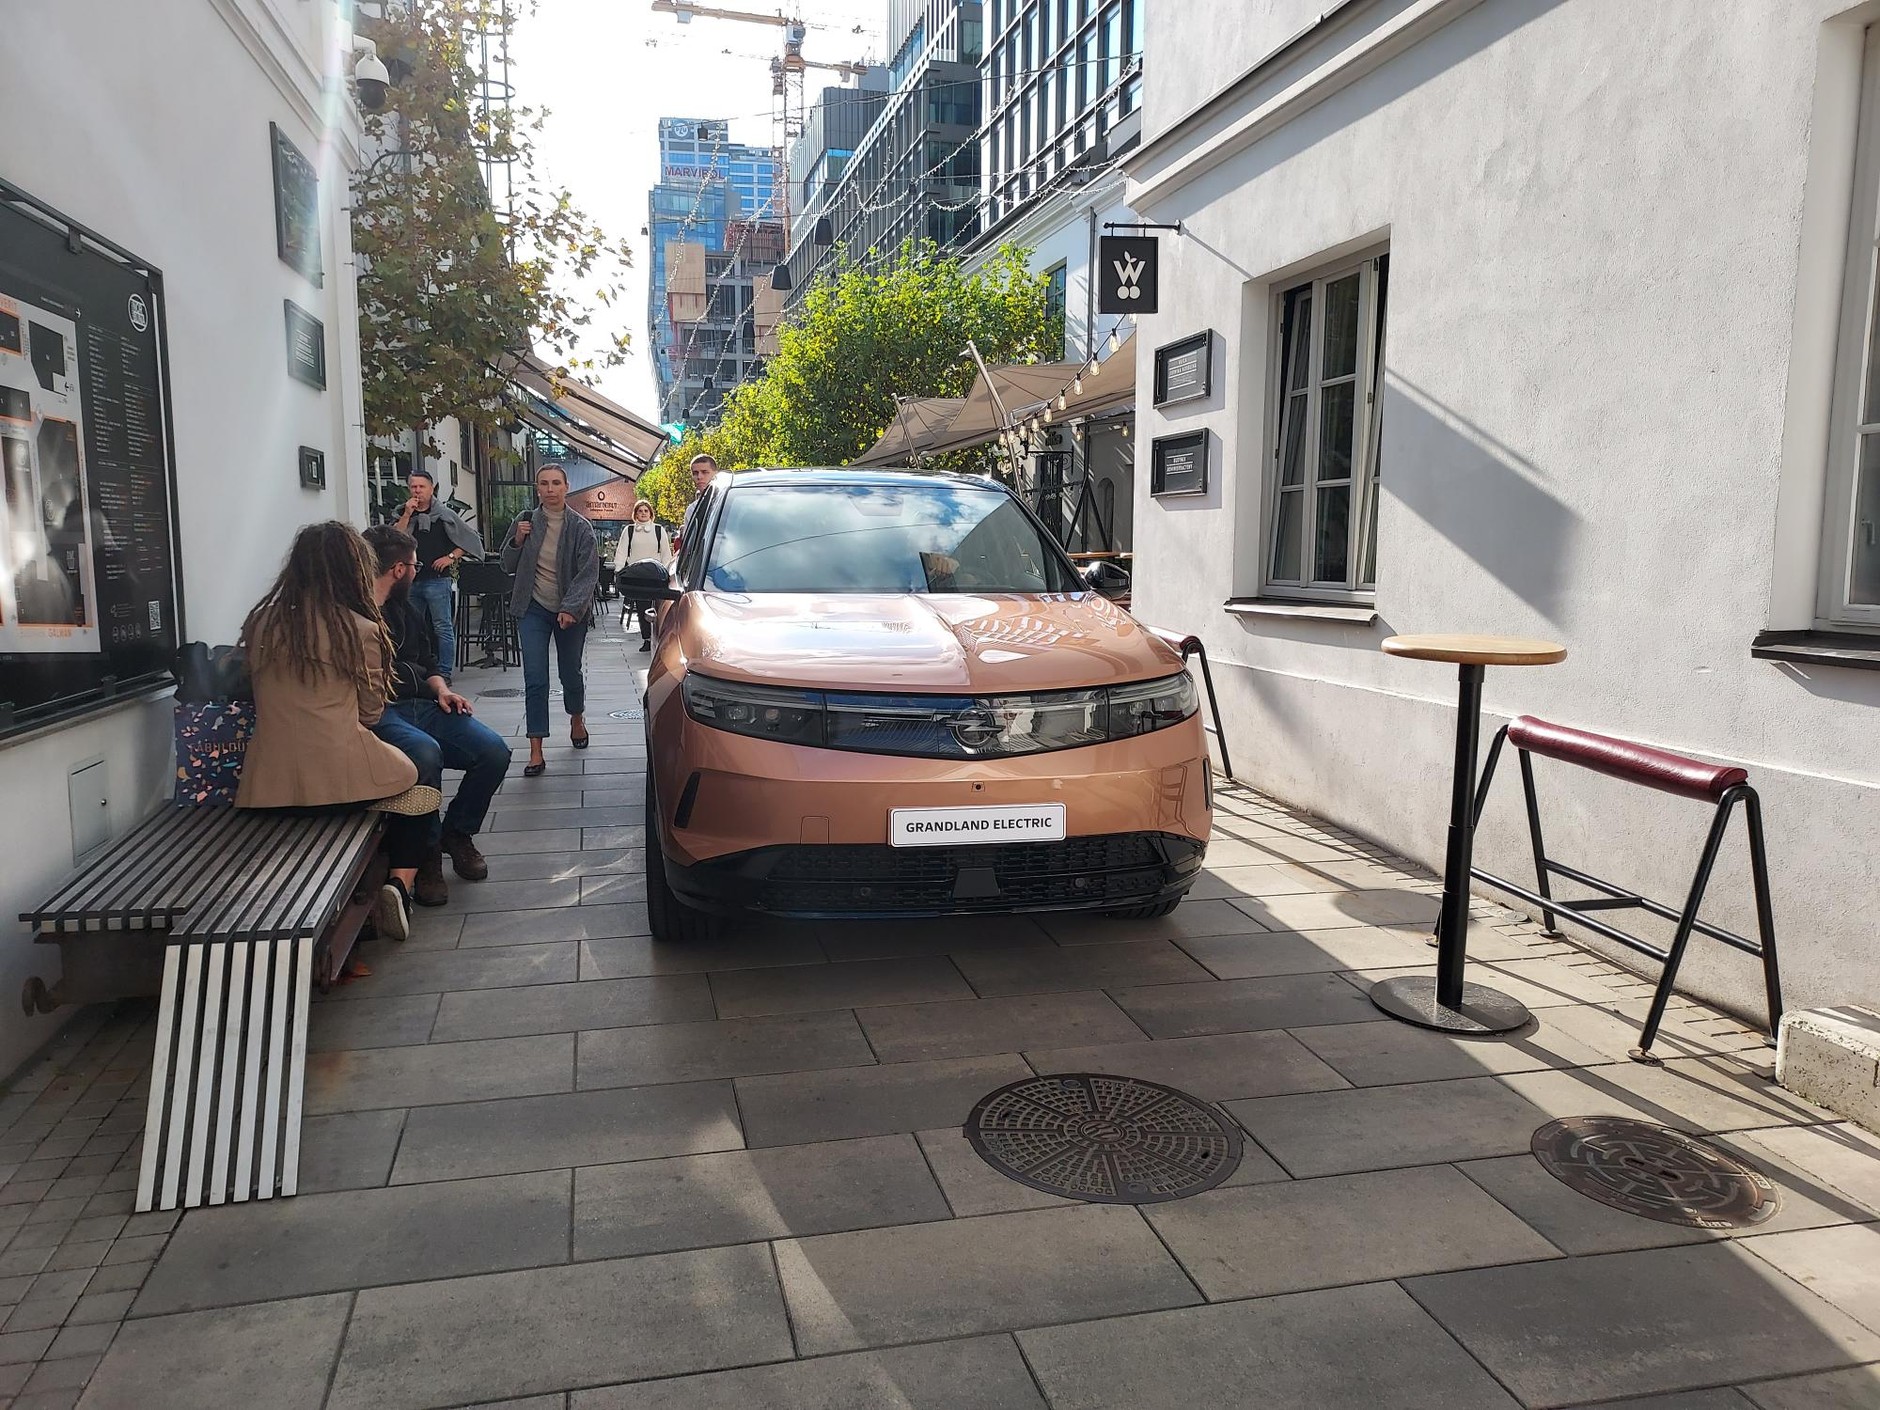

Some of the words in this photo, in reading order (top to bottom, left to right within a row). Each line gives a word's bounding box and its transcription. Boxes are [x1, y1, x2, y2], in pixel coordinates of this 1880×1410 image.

[189, 742, 247, 753] FABULOU
[906, 820, 989, 833] GRANDLAND
[993, 817, 1052, 830] ELECTRIC
